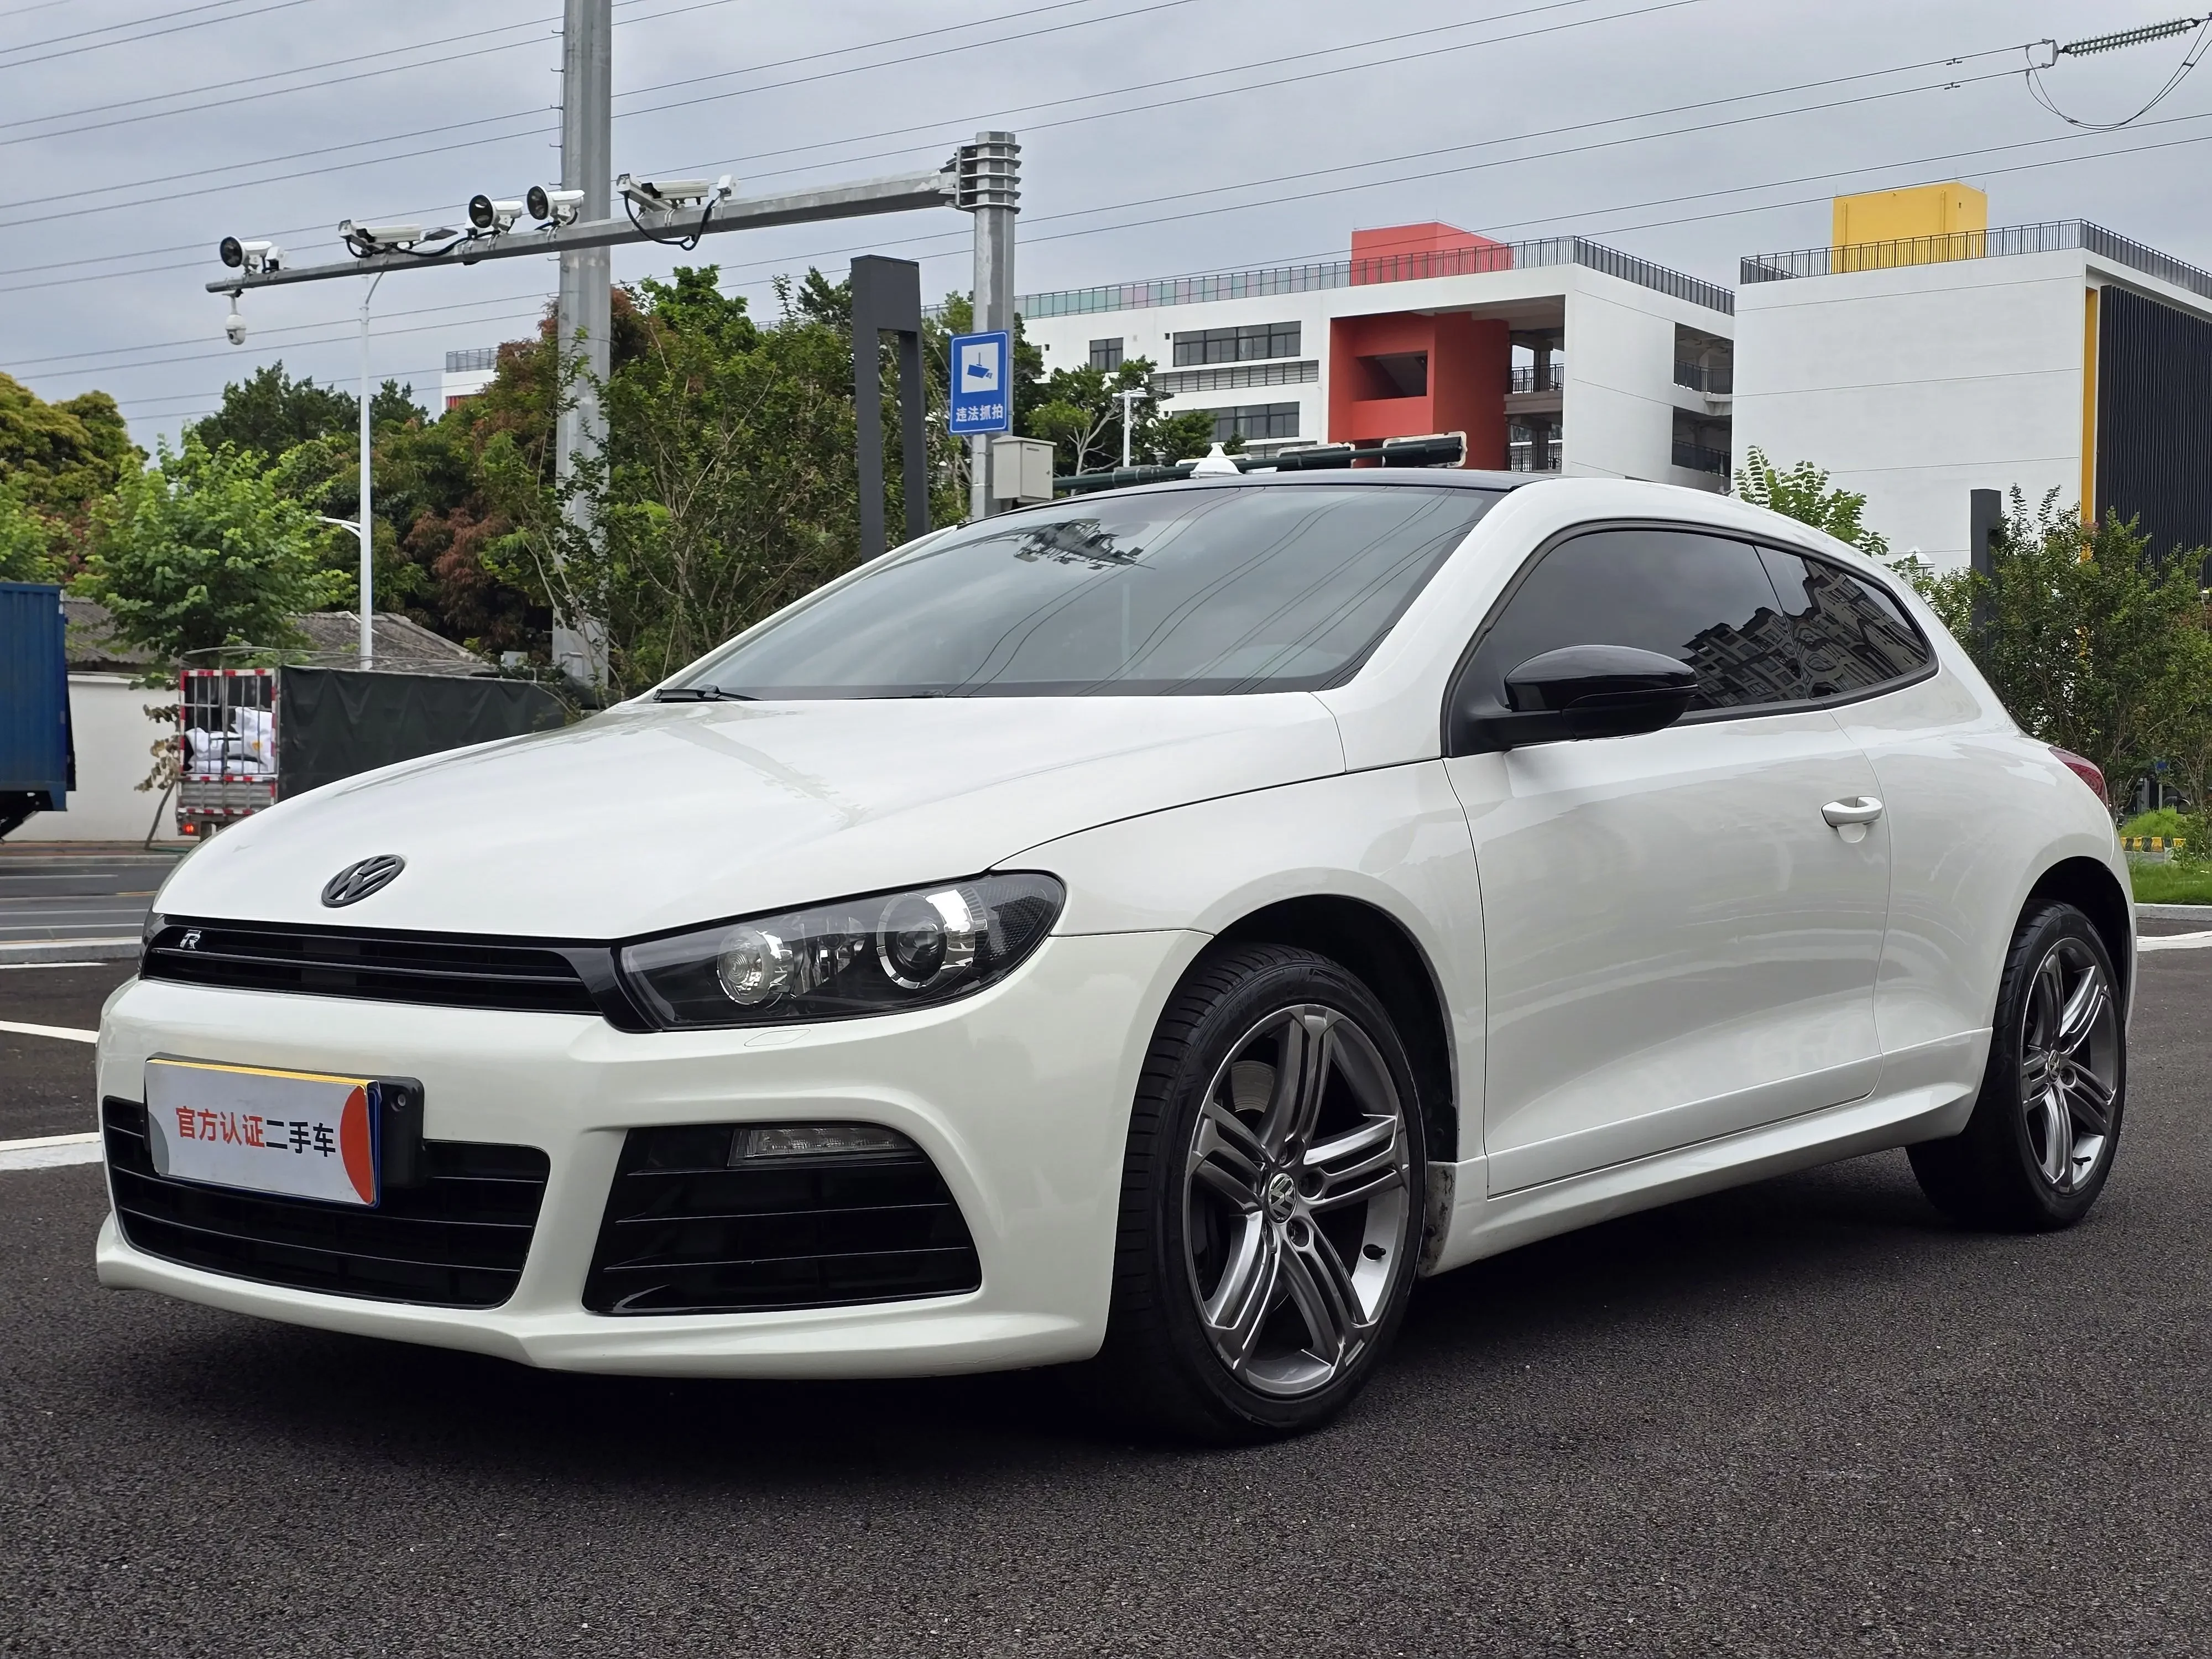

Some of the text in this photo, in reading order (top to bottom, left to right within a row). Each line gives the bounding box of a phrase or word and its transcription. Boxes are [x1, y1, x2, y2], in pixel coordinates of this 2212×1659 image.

[956, 404, 1003, 422] 违法抓拍
[180, 929, 201, 950] R
[175, 1105, 336, 1157] 官方认证二手车
